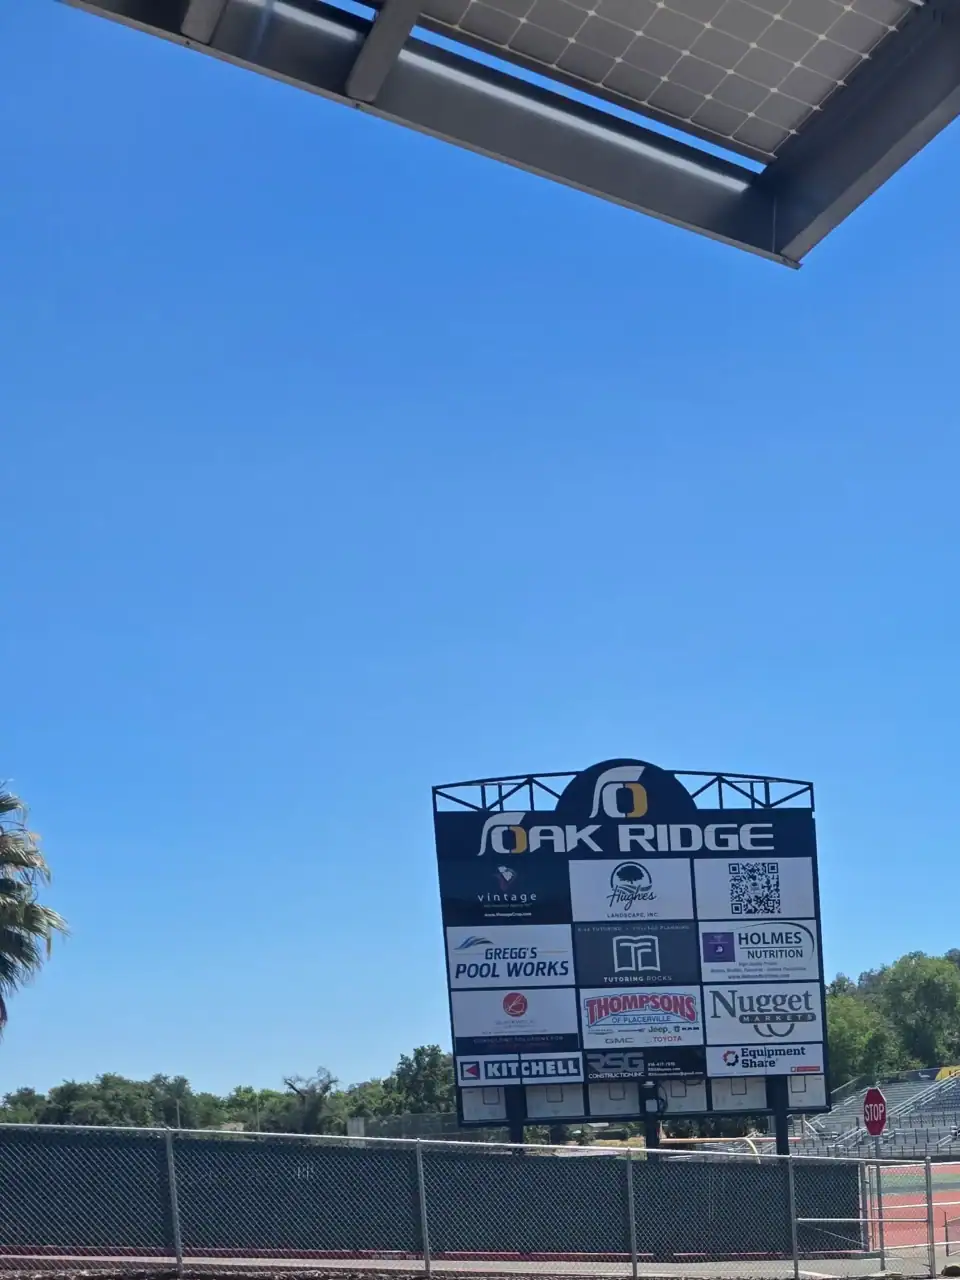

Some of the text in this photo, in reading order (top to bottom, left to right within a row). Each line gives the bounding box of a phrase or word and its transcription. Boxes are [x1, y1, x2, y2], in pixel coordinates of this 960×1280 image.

[617, 823, 775, 852] RIDGE
[477, 892, 537, 903] vintage
[606, 885, 657, 911] Hughes
[738, 931, 802, 945] HOLMES
[484, 947, 538, 960] GREGG'S
[747, 949, 803, 959] NUTRITION
[455, 960, 569, 979] POOL WORKS
[586, 994, 697, 1025] THOMPSONS
[709, 990, 814, 1019] Nugget
[623, 1015, 671, 1023] PLACERVILLE
[743, 1014, 813, 1022] MARKETS
[741, 1046, 806, 1059] Equipment
[487, 1060, 578, 1077] KITCHELL
[586, 1051, 645, 1072] RSG
[741, 1058, 776, 1068] Share
[864, 1103, 885, 1122] STOP
